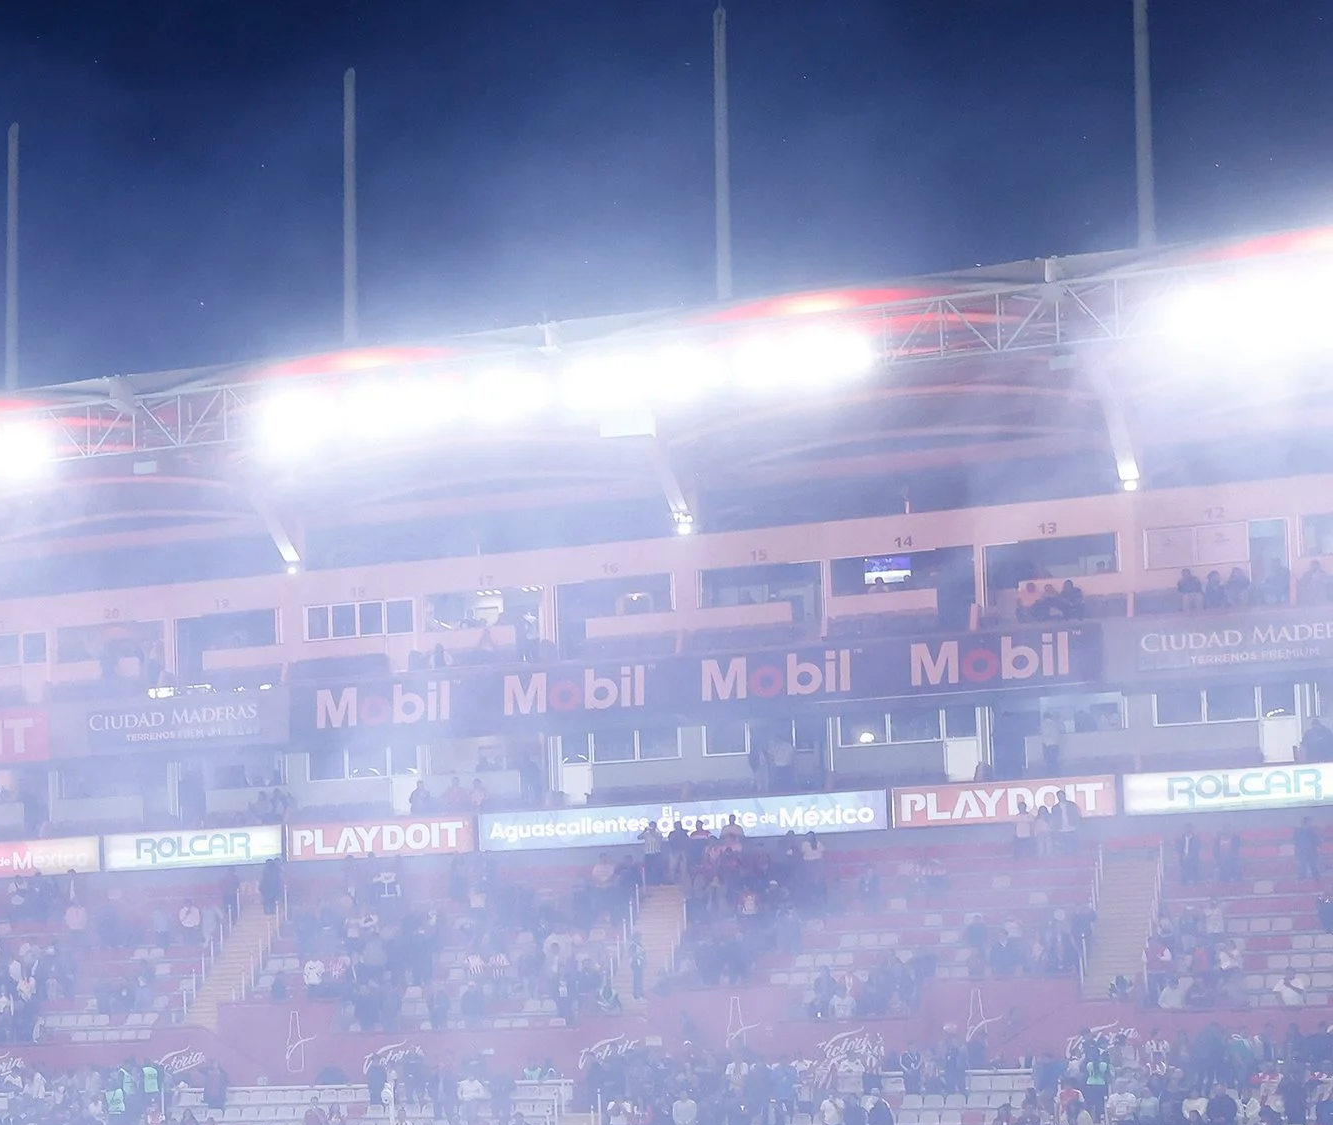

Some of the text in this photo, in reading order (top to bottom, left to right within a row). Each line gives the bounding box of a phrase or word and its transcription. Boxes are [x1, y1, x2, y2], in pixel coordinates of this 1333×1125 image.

[894, 535, 914, 548] 14
[1037, 522, 1058, 535] 13
[1140, 630, 1244, 652] CIUDAD
[701, 648, 851, 702] Mobil
[910, 631, 1070, 687] Mobil
[316, 680, 450, 729] Mobil
[503, 664, 645, 717] Mobil
[89, 703, 258, 732] CIUDAD MADERAS
[1166, 768, 1323, 809] ROLCAR
[293, 821, 463, 855] PLAYDOIT
[489, 815, 649, 843] Aguascalientes
[759, 811, 777, 824] de
[778, 804, 875, 828] México
[12, 846, 89, 871] México
[135, 832, 250, 863] ROLCAR
